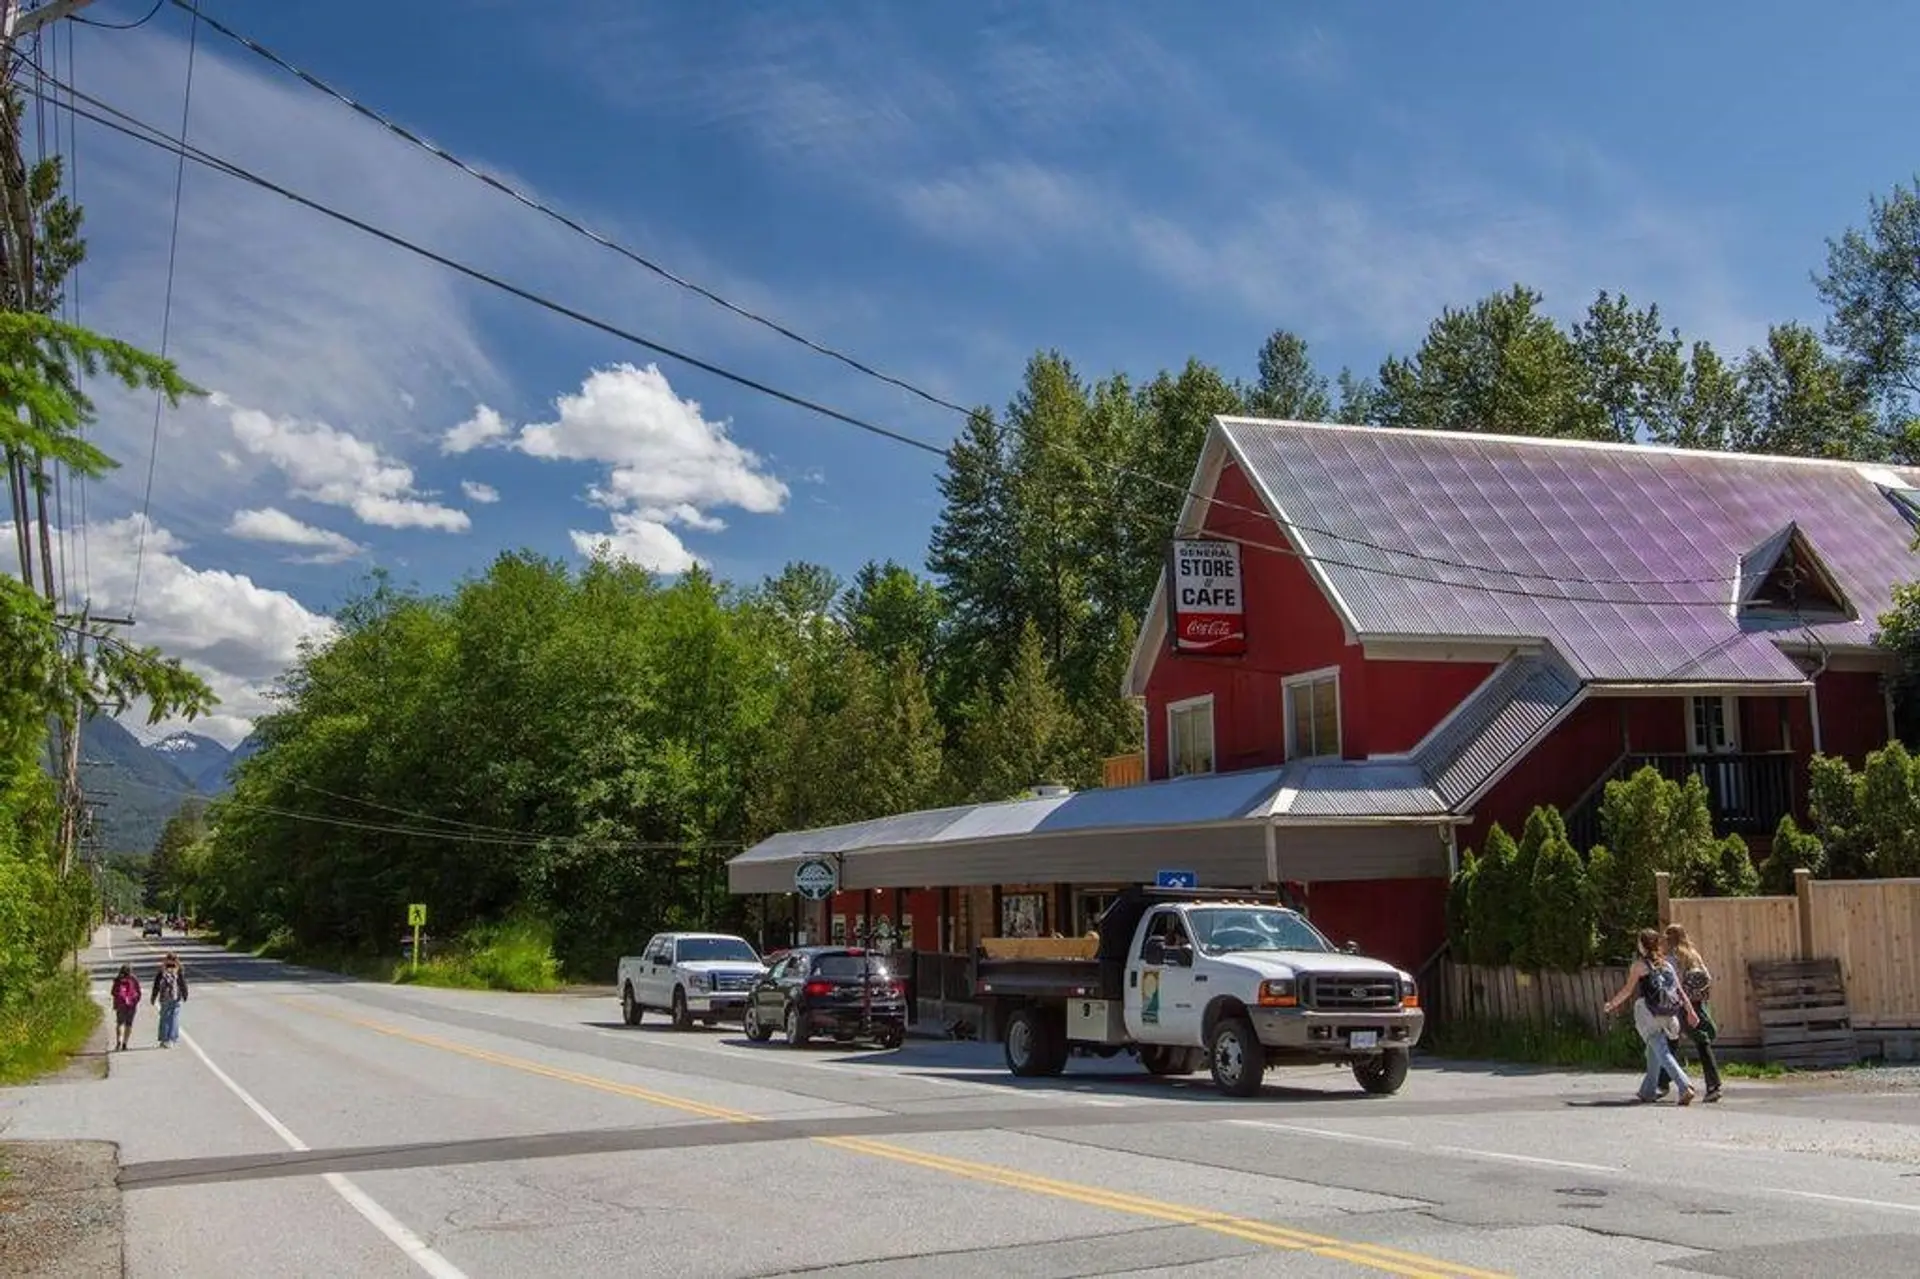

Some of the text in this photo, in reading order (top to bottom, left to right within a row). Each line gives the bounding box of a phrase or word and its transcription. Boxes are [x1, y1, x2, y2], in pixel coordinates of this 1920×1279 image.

[1179, 548, 1233, 558] GENERAL
[1181, 559, 1234, 577] STORE
[1182, 588, 1235, 606] CAFE
